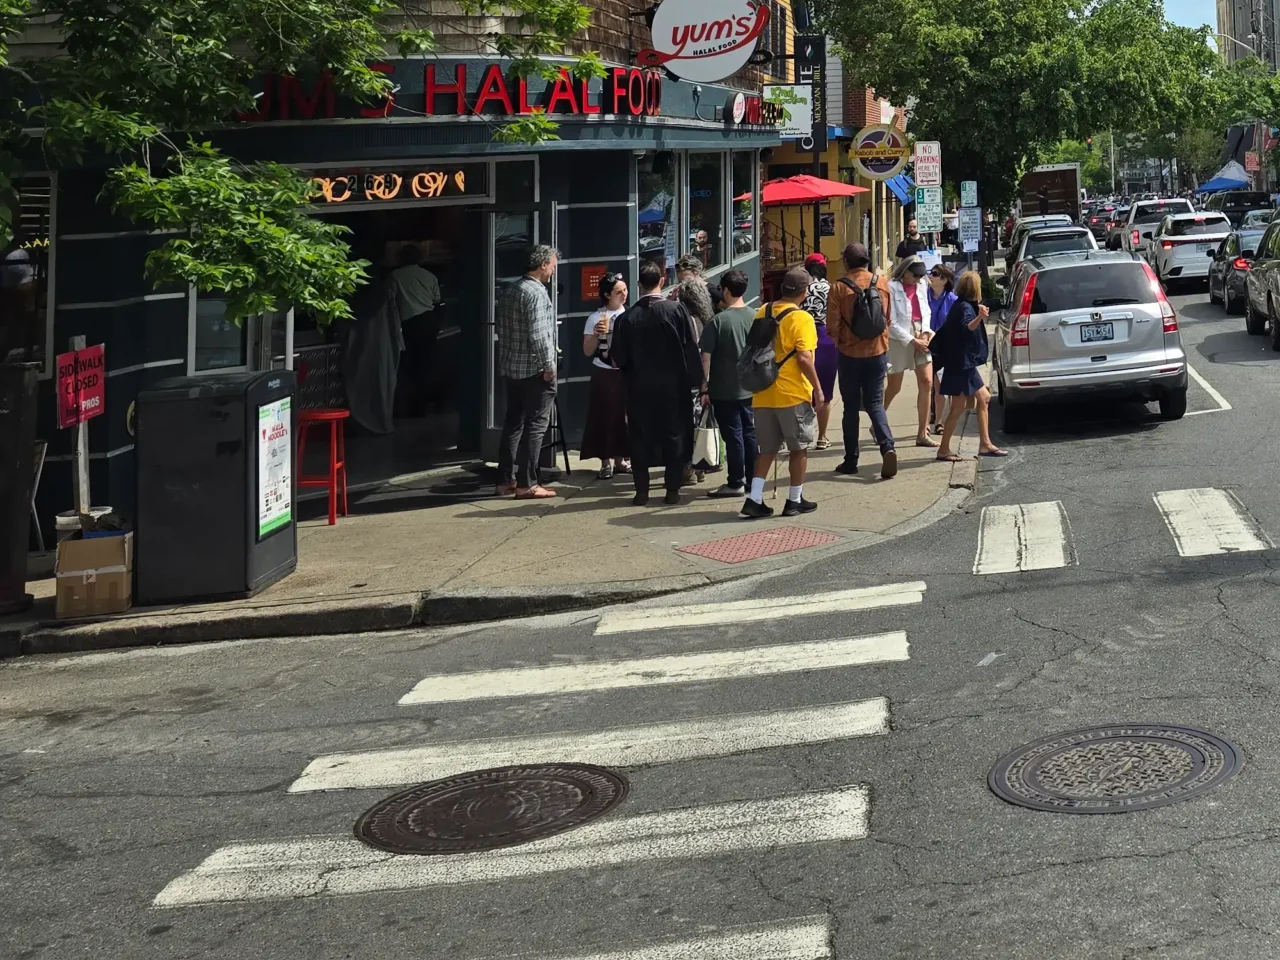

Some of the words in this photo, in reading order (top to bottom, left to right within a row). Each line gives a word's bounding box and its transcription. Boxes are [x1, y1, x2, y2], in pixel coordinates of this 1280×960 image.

[692, 46, 717, 56] HALAL
[718, 39, 738, 51] FOOD
[887, 149, 905, 157] Curry
[922, 145, 932, 154] NO
[916, 155, 939, 164] PARKING
[917, 164, 931, 172] HERE
[918, 189, 923, 198] 3
[65, 374, 98, 395] CLOSED
[81, 395, 100, 411] PROS
